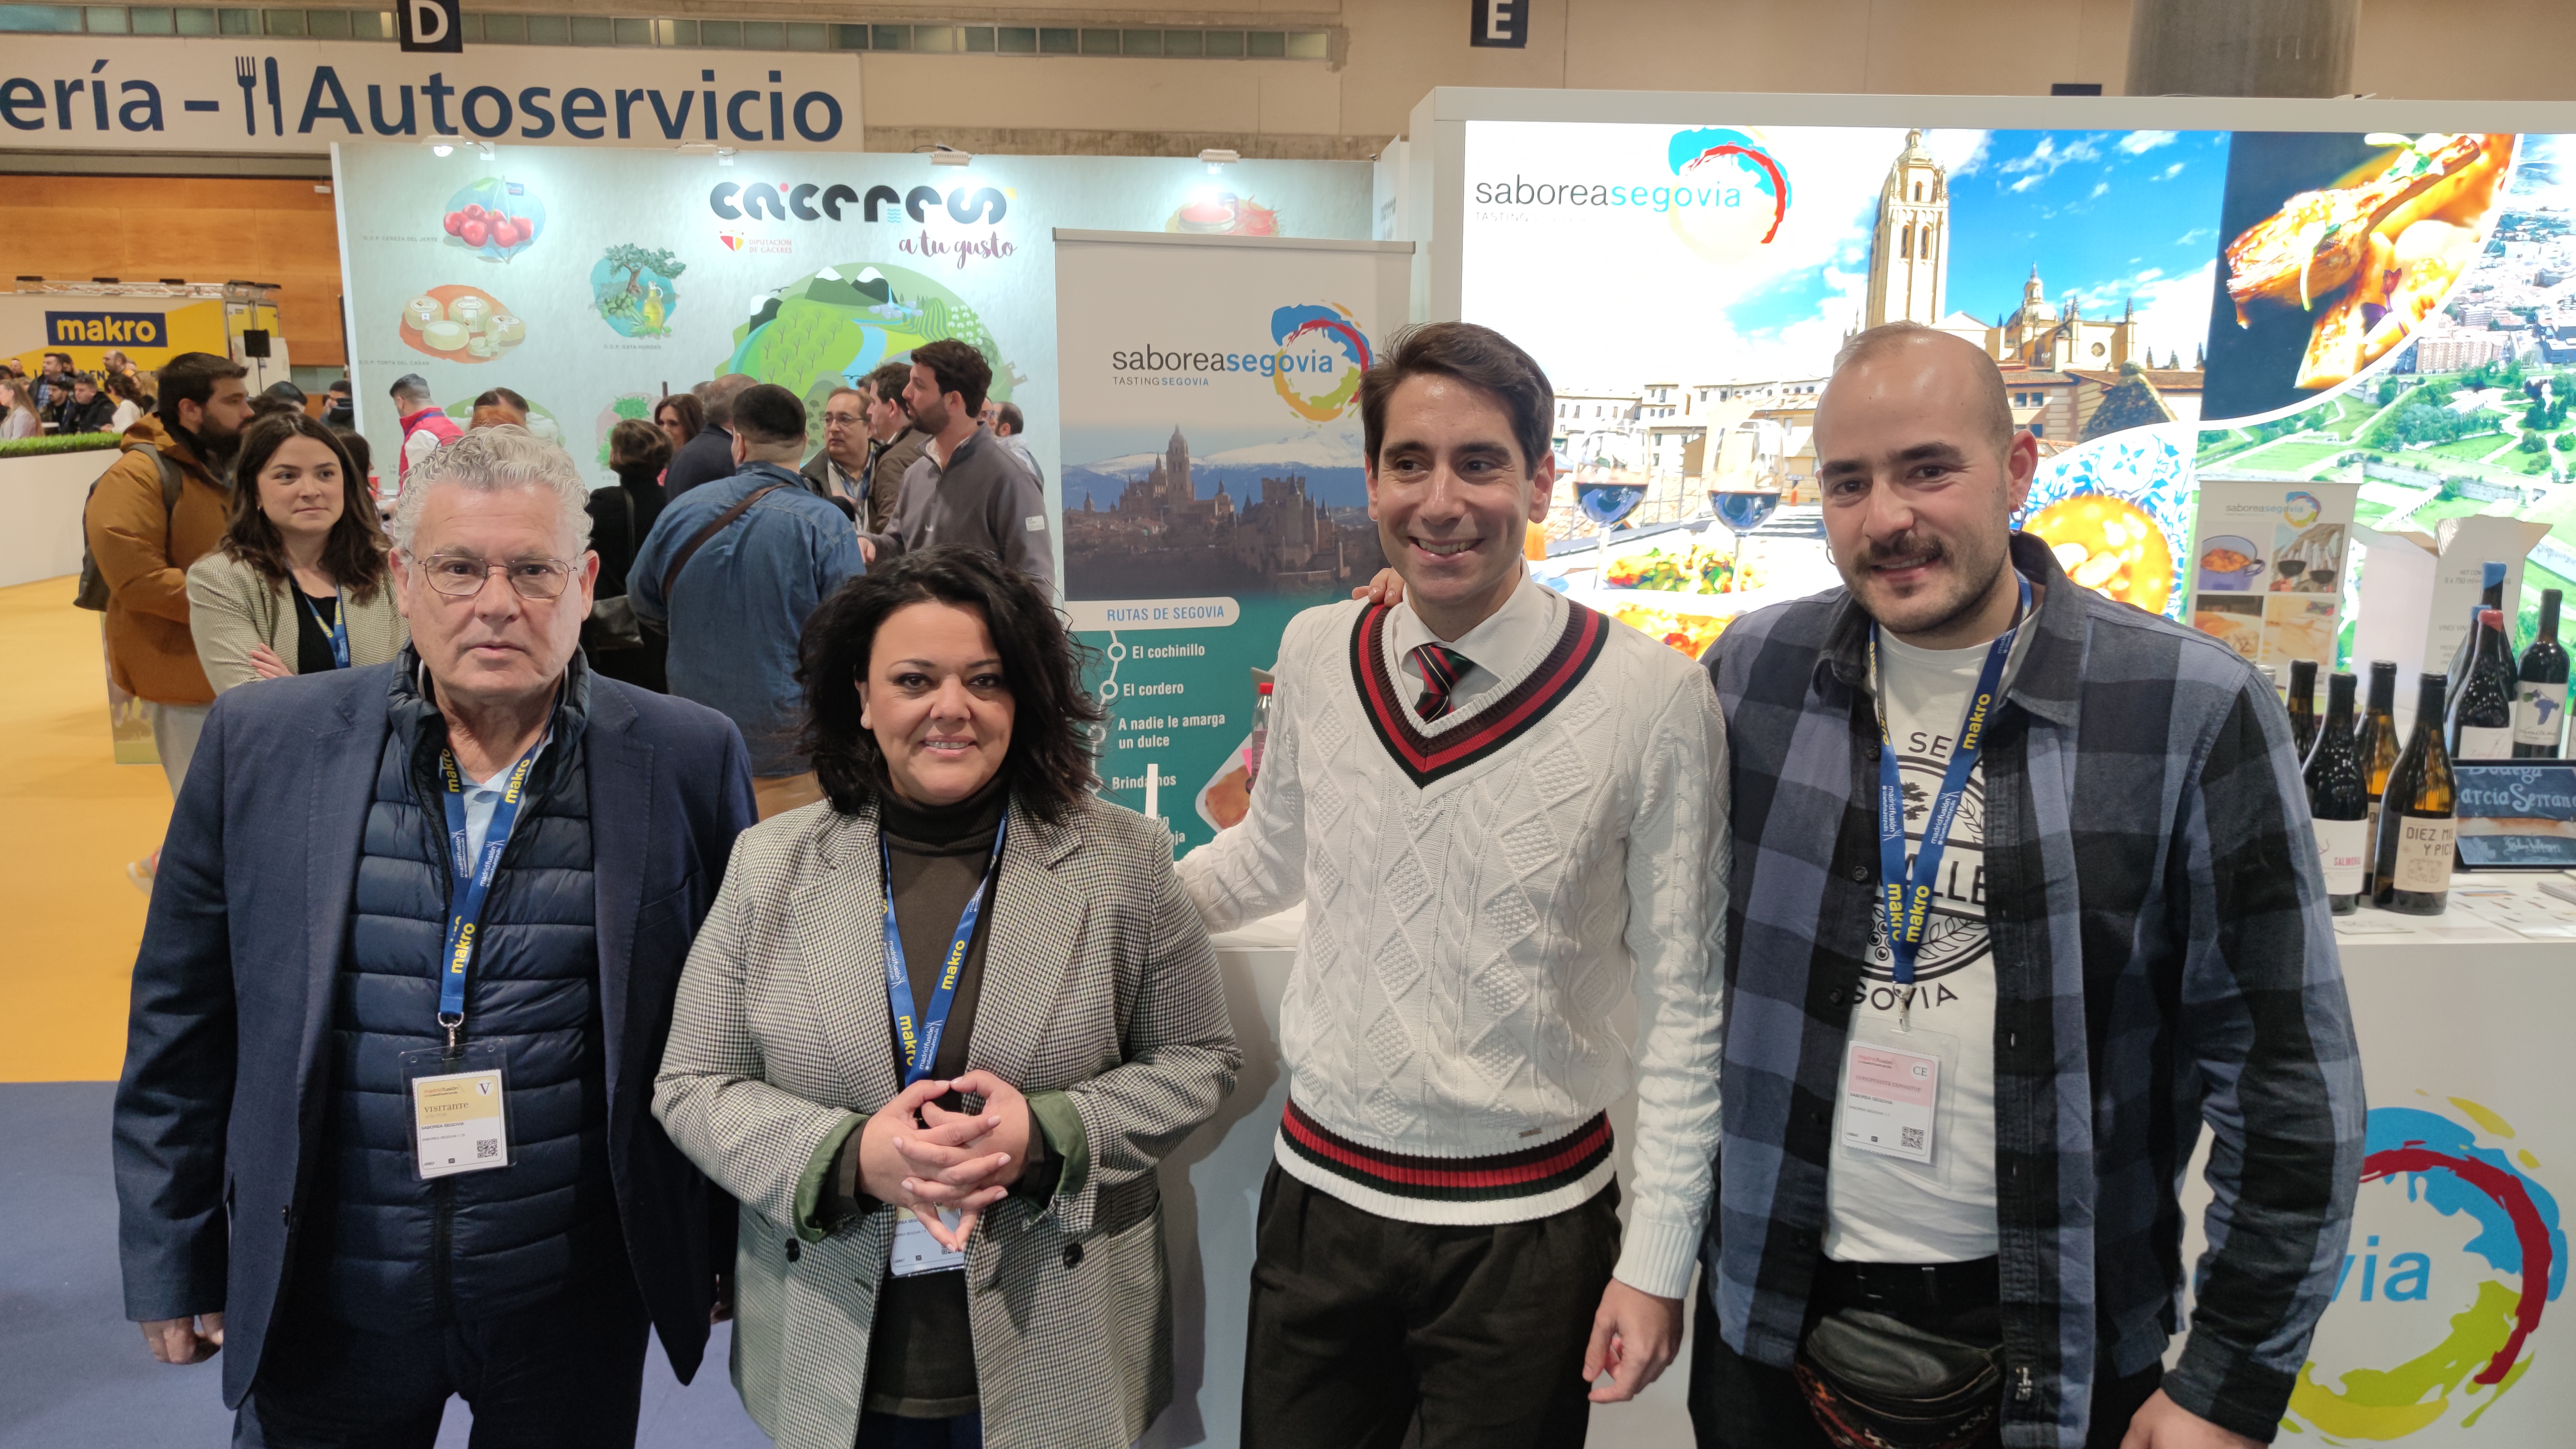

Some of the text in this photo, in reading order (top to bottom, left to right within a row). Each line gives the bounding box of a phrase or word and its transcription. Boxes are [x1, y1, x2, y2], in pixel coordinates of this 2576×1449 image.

[410, 0, 448, 43] D
[1487, 0, 1512, 39] E
[297, 66, 843, 142] Autoservicio
[899, 229, 1018, 270] a tu gusto
[56, 315, 156, 342] makro
[1107, 606, 1224, 622] RUTAS DE SEGOVIA
[1132, 643, 1205, 659] El cochinillo
[1123, 682, 1184, 696] El cordero
[1118, 714, 1225, 731] A nadie le amarga
[1119, 735, 1170, 749] un dulce
[1962, 694, 1991, 750] makro
[442, 748, 460, 793] makro
[504, 759, 530, 804] makro
[2406, 826, 2436, 841] DIEZ
[2423, 843, 2431, 856] Y
[479, 846, 497, 887] madridfusión
[1906, 885, 1930, 942] makro
[451, 923, 475, 974] makro
[941, 939, 965, 991] makro
[919, 1026, 935, 1069] madridfusión
[478, 1082, 492, 1095] V
[1913, 1066, 1928, 1076] CE
